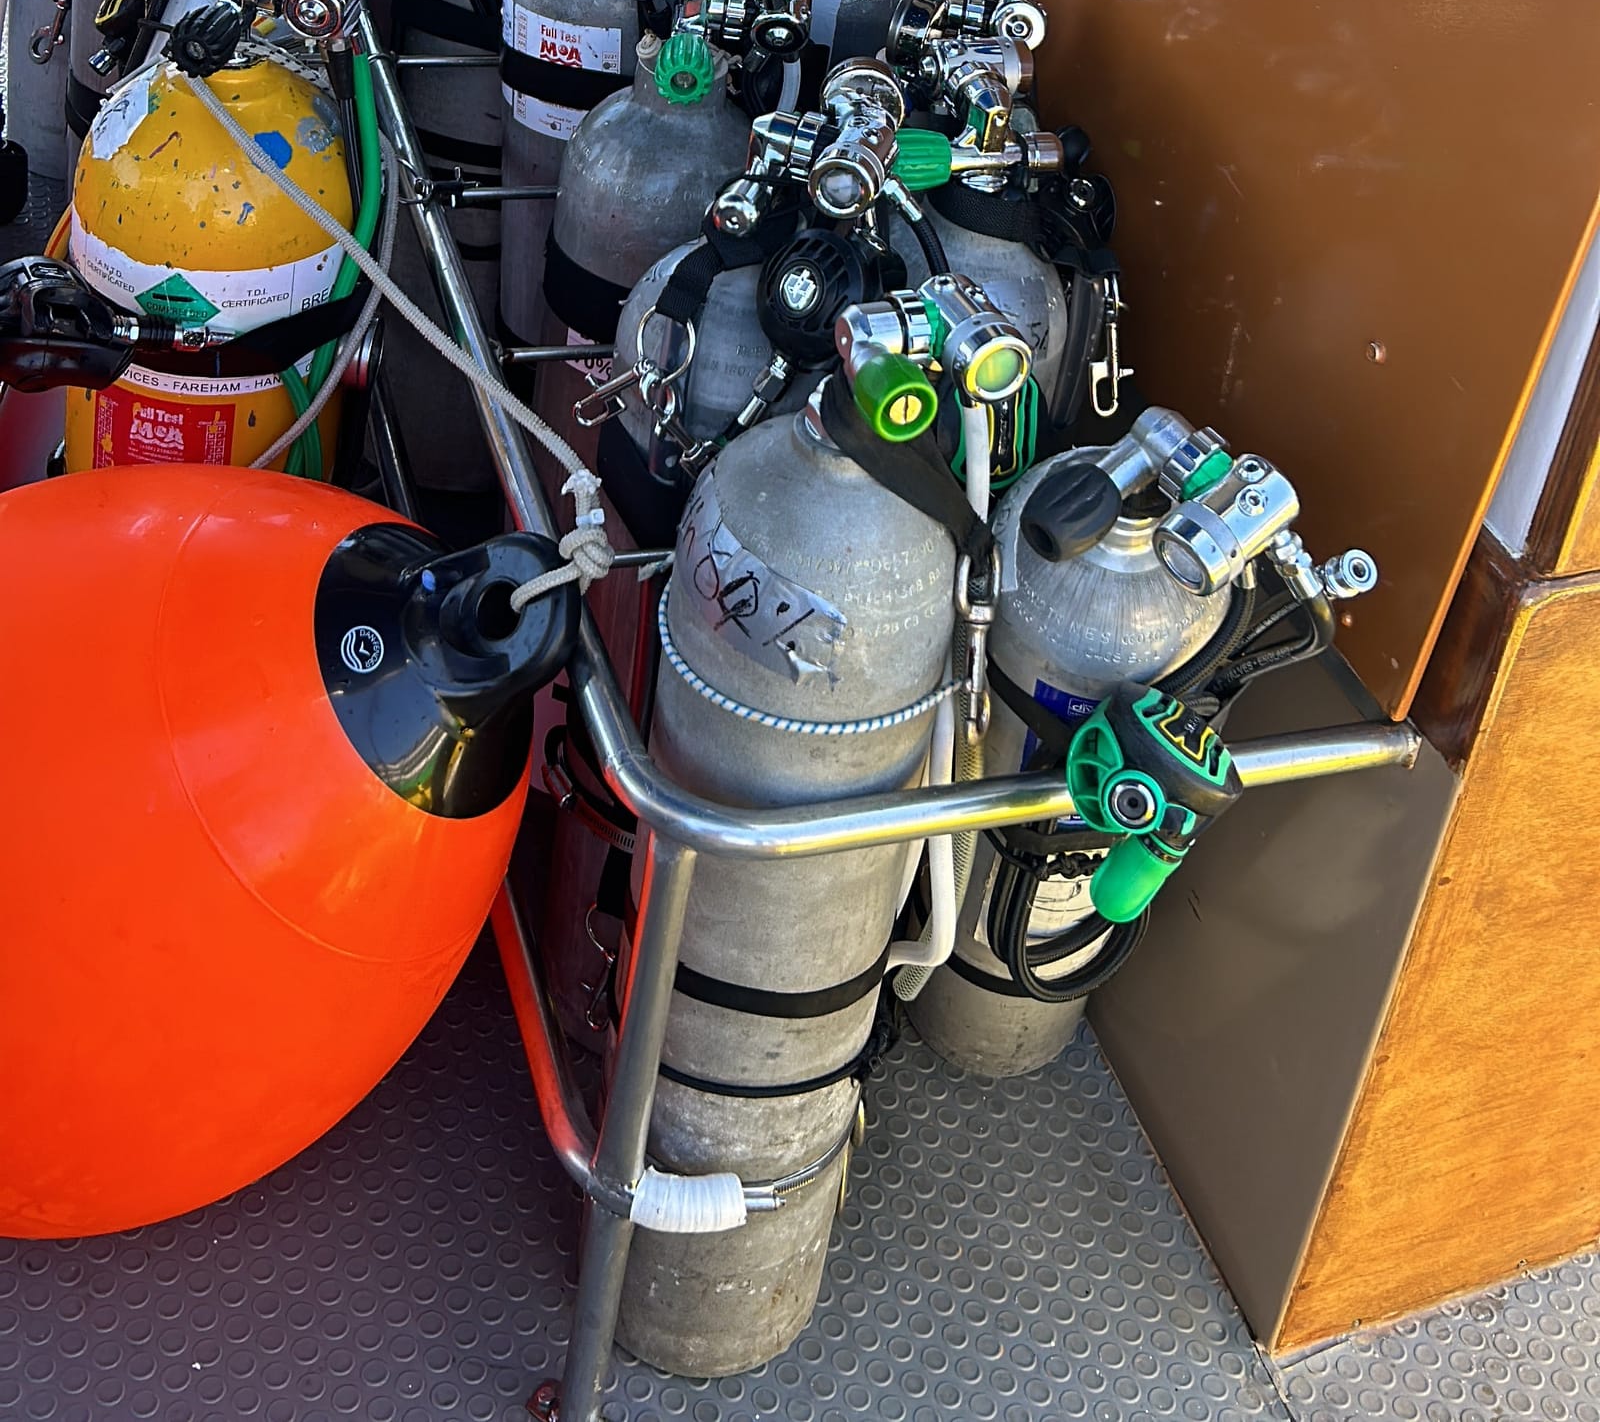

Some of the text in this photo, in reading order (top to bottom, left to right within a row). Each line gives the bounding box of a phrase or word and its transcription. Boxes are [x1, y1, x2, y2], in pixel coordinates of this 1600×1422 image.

[541, 24, 582, 44] Full Test
[87, 259, 135, 294] CERTIFICATED
[221, 293, 289, 308] CERTIFICATED
[302, 284, 334, 311] BRE
[173, 381, 241, 392] FAREHAM
[254, 375, 281, 389] HAN
[156, 410, 184, 425] Test
